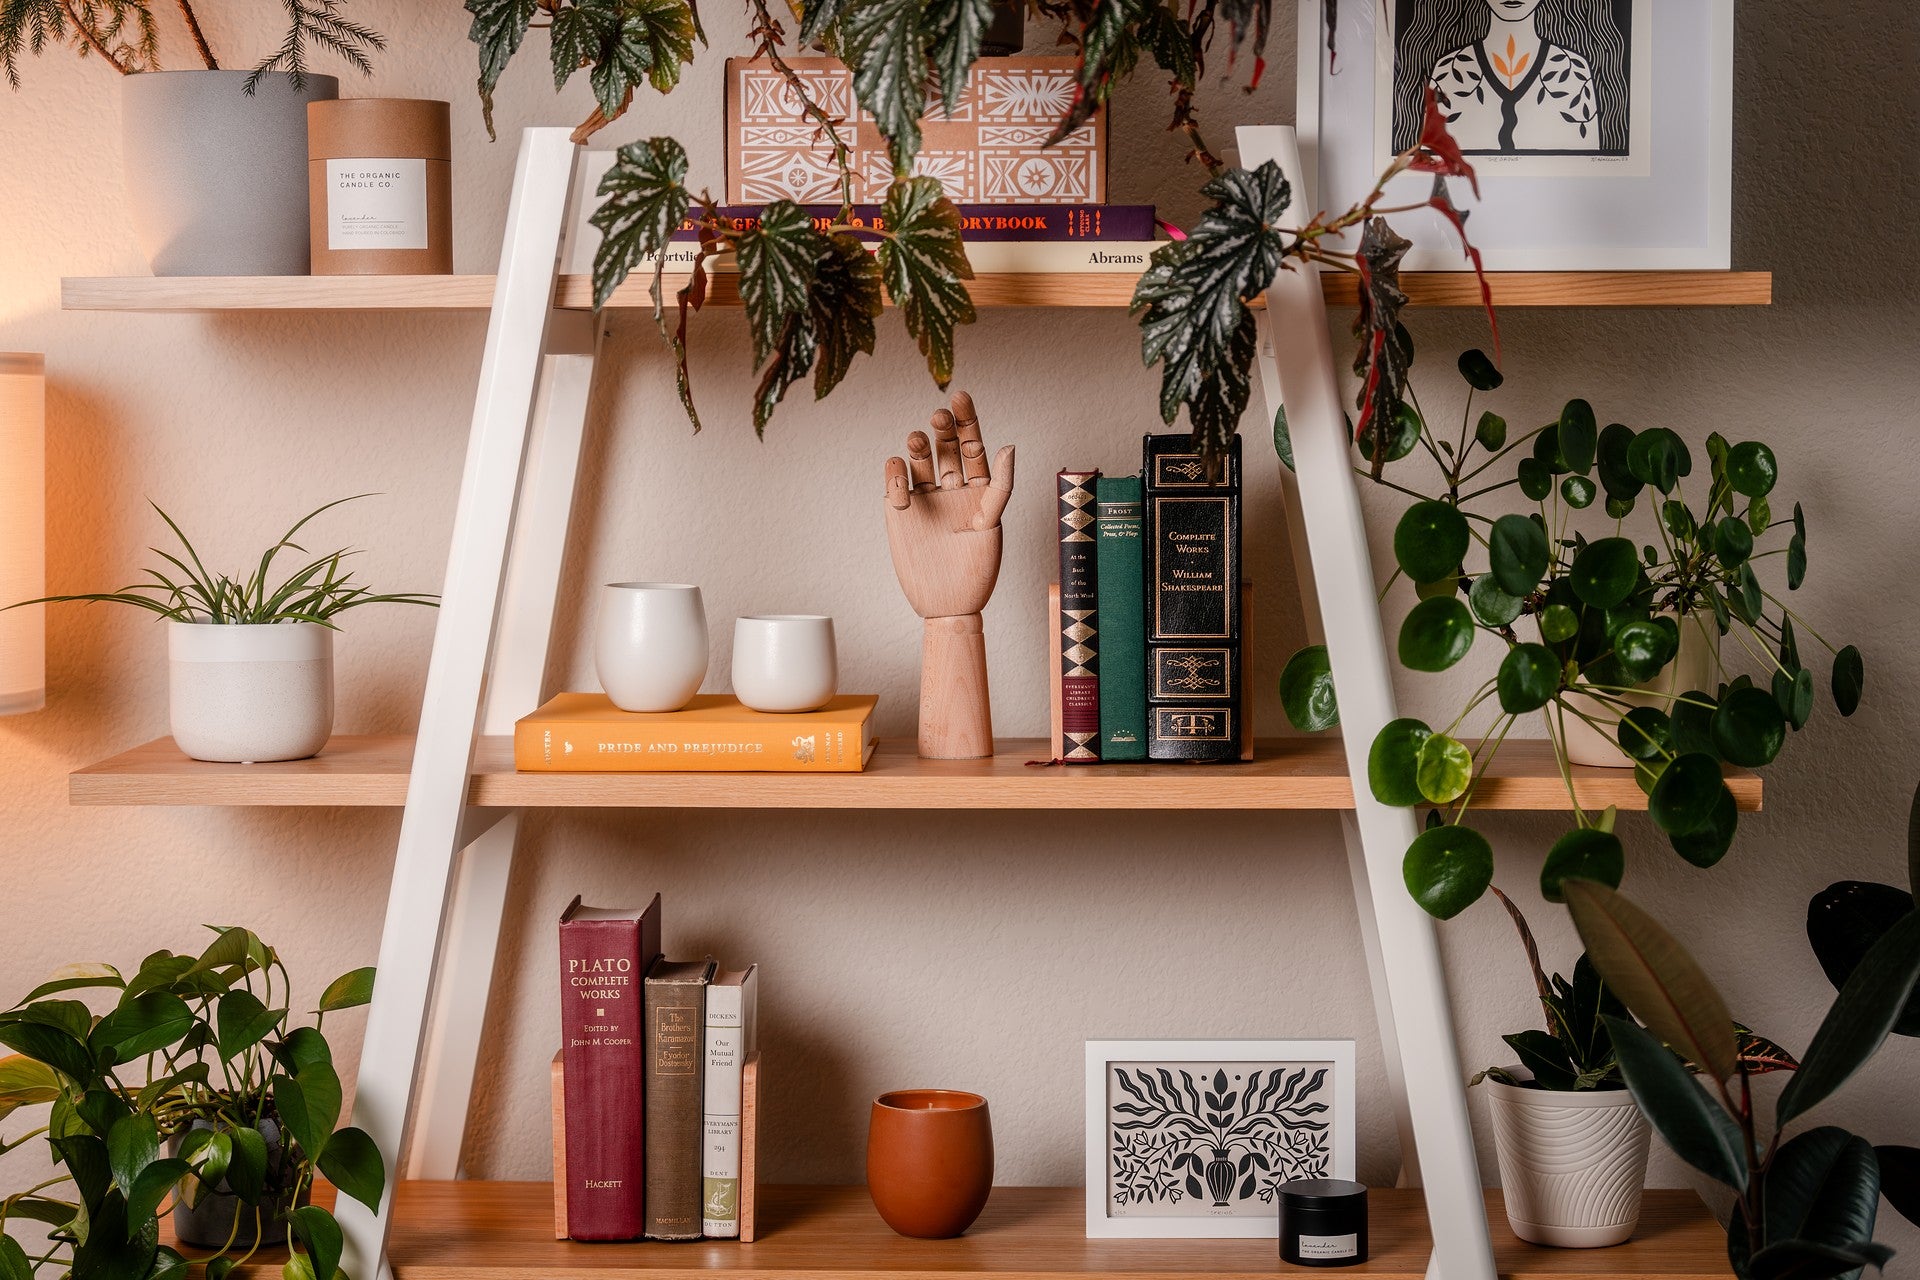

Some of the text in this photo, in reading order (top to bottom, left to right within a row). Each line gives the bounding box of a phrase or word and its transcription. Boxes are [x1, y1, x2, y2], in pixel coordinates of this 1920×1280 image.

[959, 216, 1048, 230] ORYBOOK
[1088, 251, 1144, 264] Abrams
[598, 743, 763, 755] PRIDE AND PREJUDICE
[569, 958, 631, 973] PLATO
[571, 976, 629, 987] COMPLETE
[580, 989, 621, 1000] WORKS
[669, 1013, 684, 1022] The
[610, 1025, 619, 1033] BY
[661, 1022, 691, 1033] Brothers
[715, 1039, 730, 1047] Our
[663, 1051, 690, 1060] Fyodor
[709, 1049, 734, 1057] Mutual
[711, 1059, 733, 1067] Friend
[714, 1144, 726, 1152] 294
